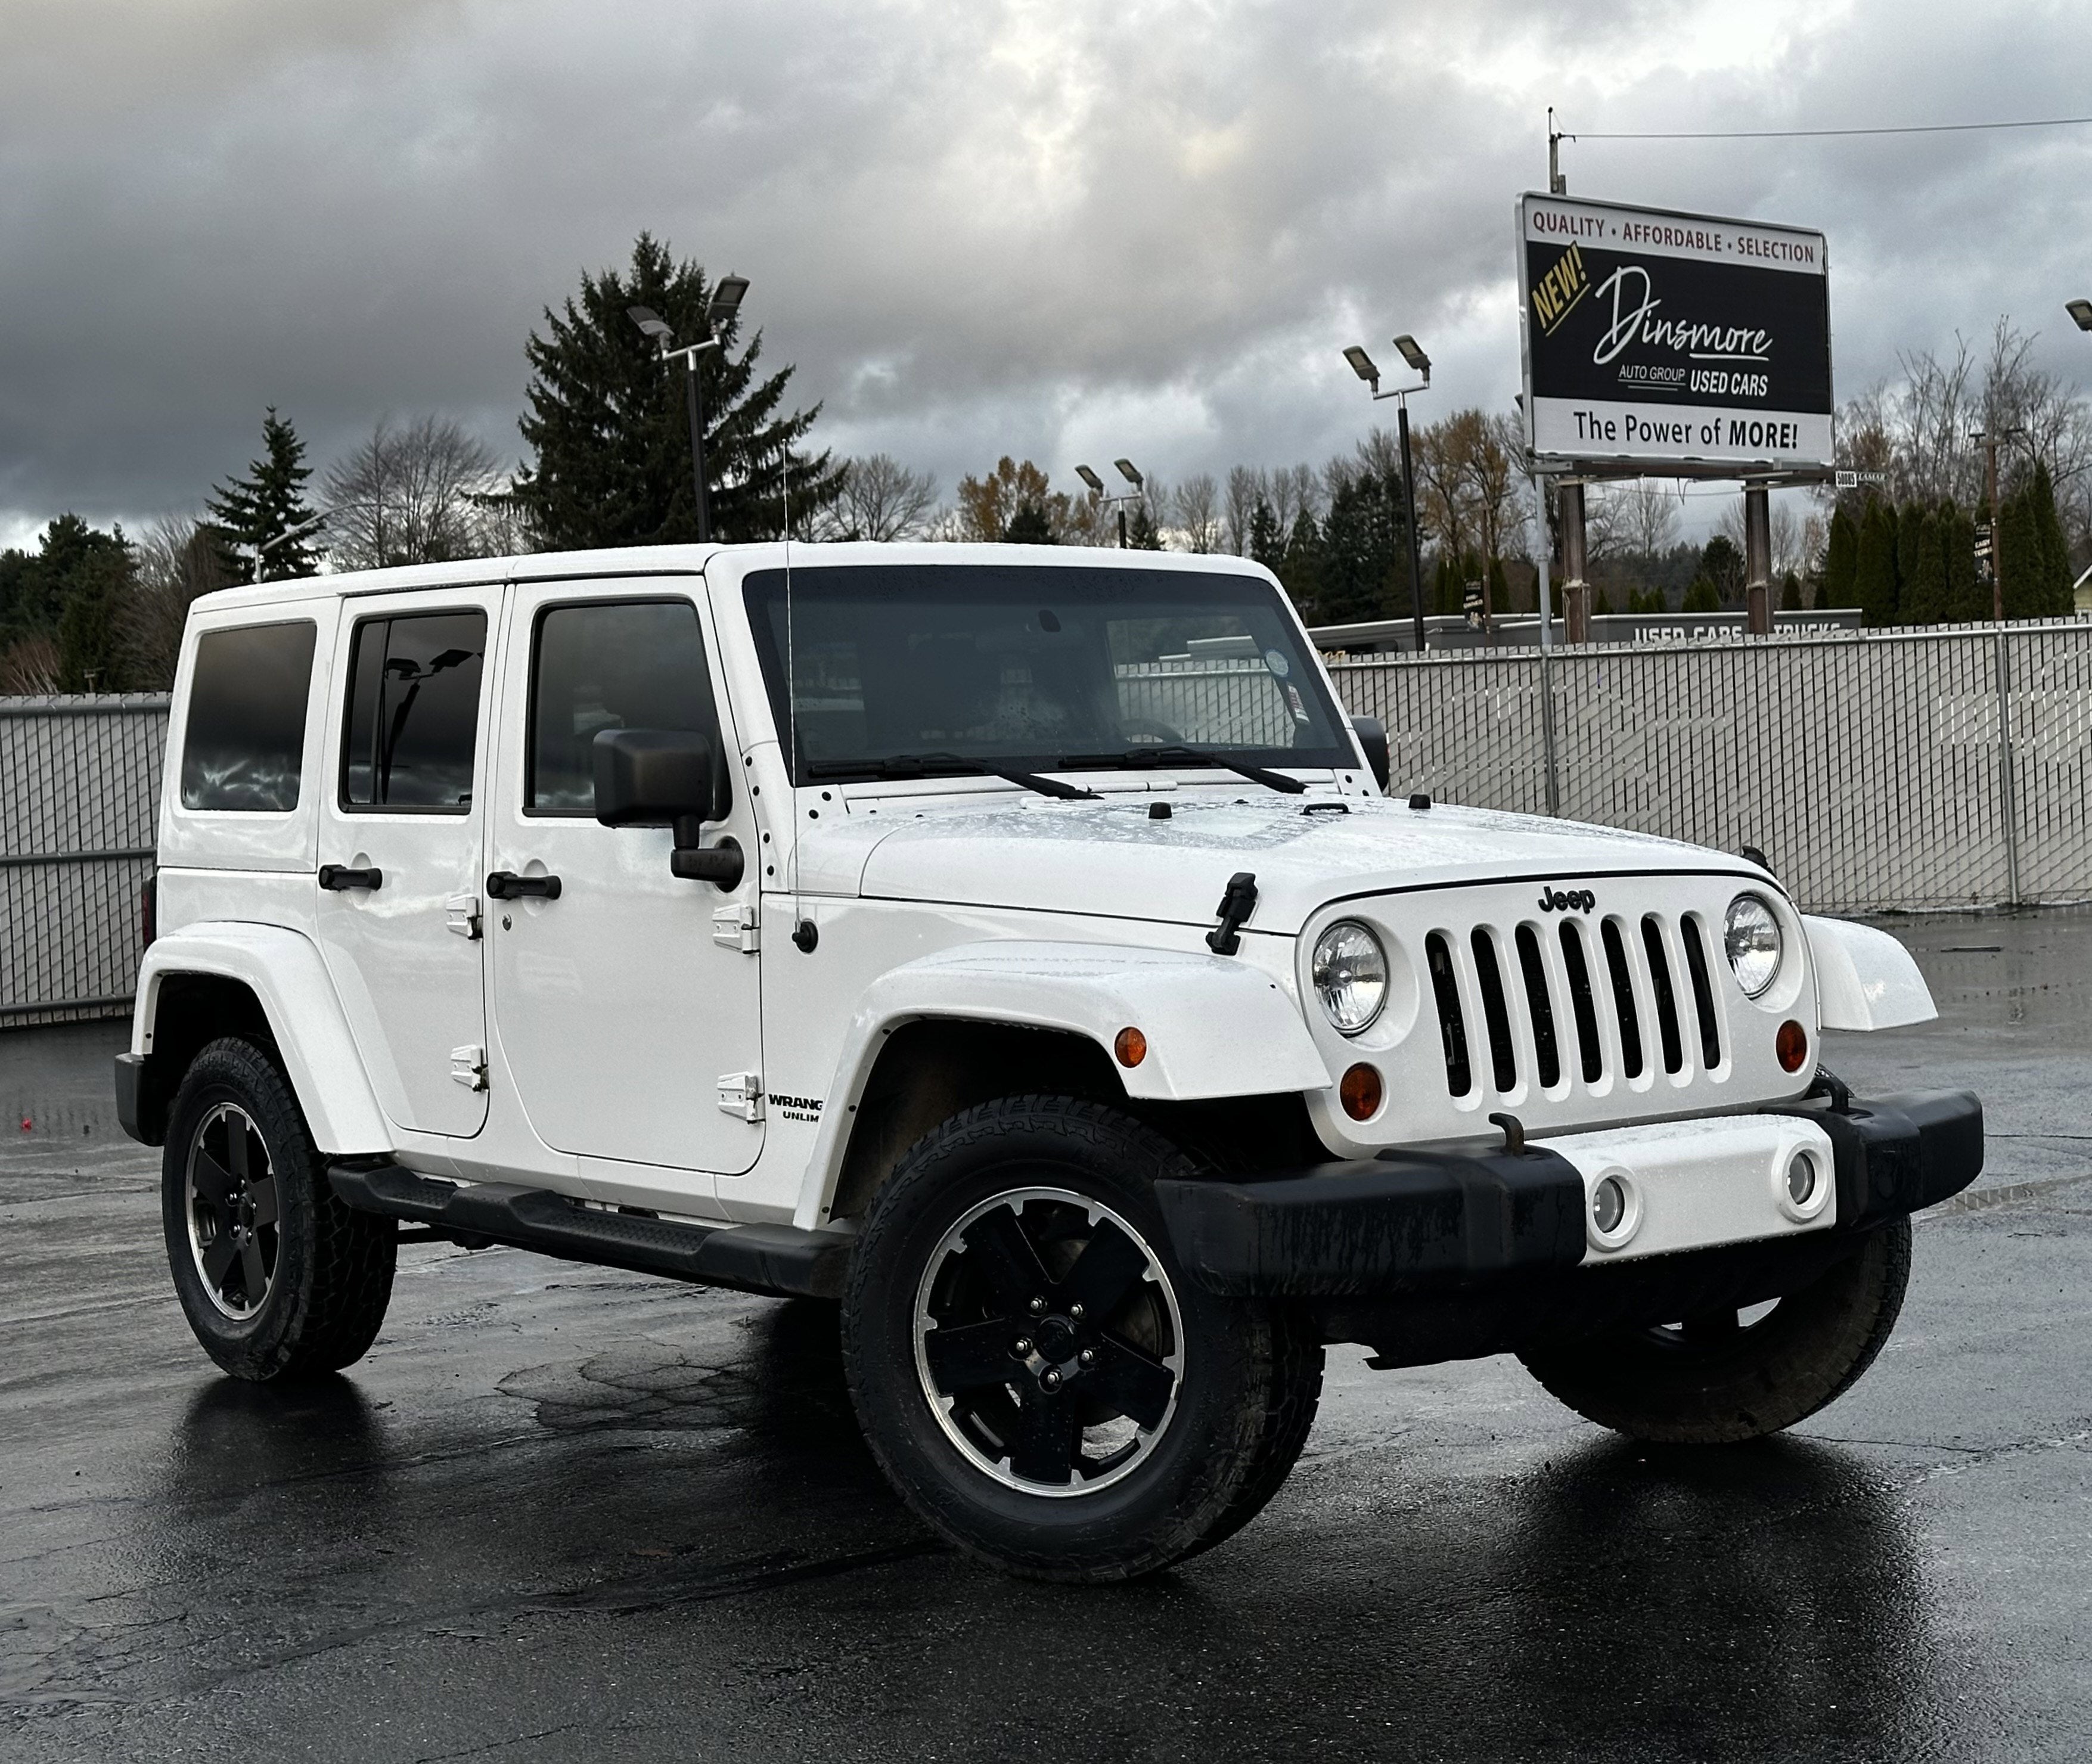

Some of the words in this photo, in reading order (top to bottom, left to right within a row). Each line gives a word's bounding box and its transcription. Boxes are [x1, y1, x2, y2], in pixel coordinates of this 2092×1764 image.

[1534, 212, 1604, 237] QUALITY
[1623, 222, 1721, 252] AFFORDABLE
[1738, 237, 1813, 263] SELECTION
[1532, 243, 1586, 329] NEW!
[1594, 266, 1773, 364] Dinsmore
[1619, 364, 1647, 379] AUTO
[1649, 366, 1686, 381] GROUP
[1690, 369, 1728, 393] USED
[1731, 372, 1768, 396] CARS
[1573, 411, 1616, 440] The
[1625, 414, 1691, 443] Power
[1700, 417, 1721, 445] of
[1728, 420, 1798, 449] MORE!
[1538, 886, 1596, 914] Jeep
[768, 1094, 823, 1111] WRANG
[783, 1111, 819, 1123] UNLIM
